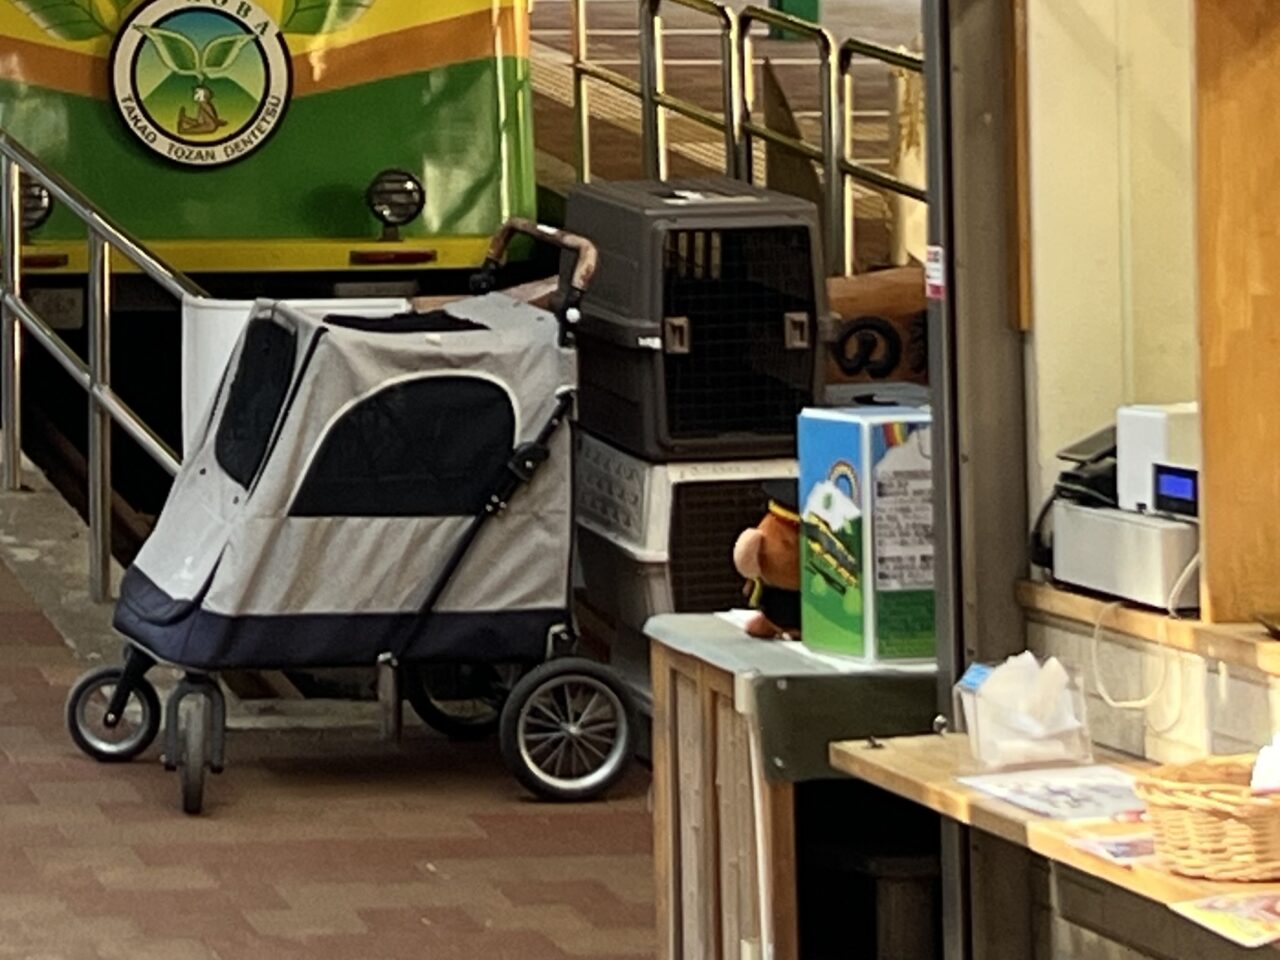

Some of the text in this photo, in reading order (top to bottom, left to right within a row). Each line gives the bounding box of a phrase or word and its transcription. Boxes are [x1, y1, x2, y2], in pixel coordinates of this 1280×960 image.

[120, 93, 282, 161] TAKAO TOZAN DENTETSU
